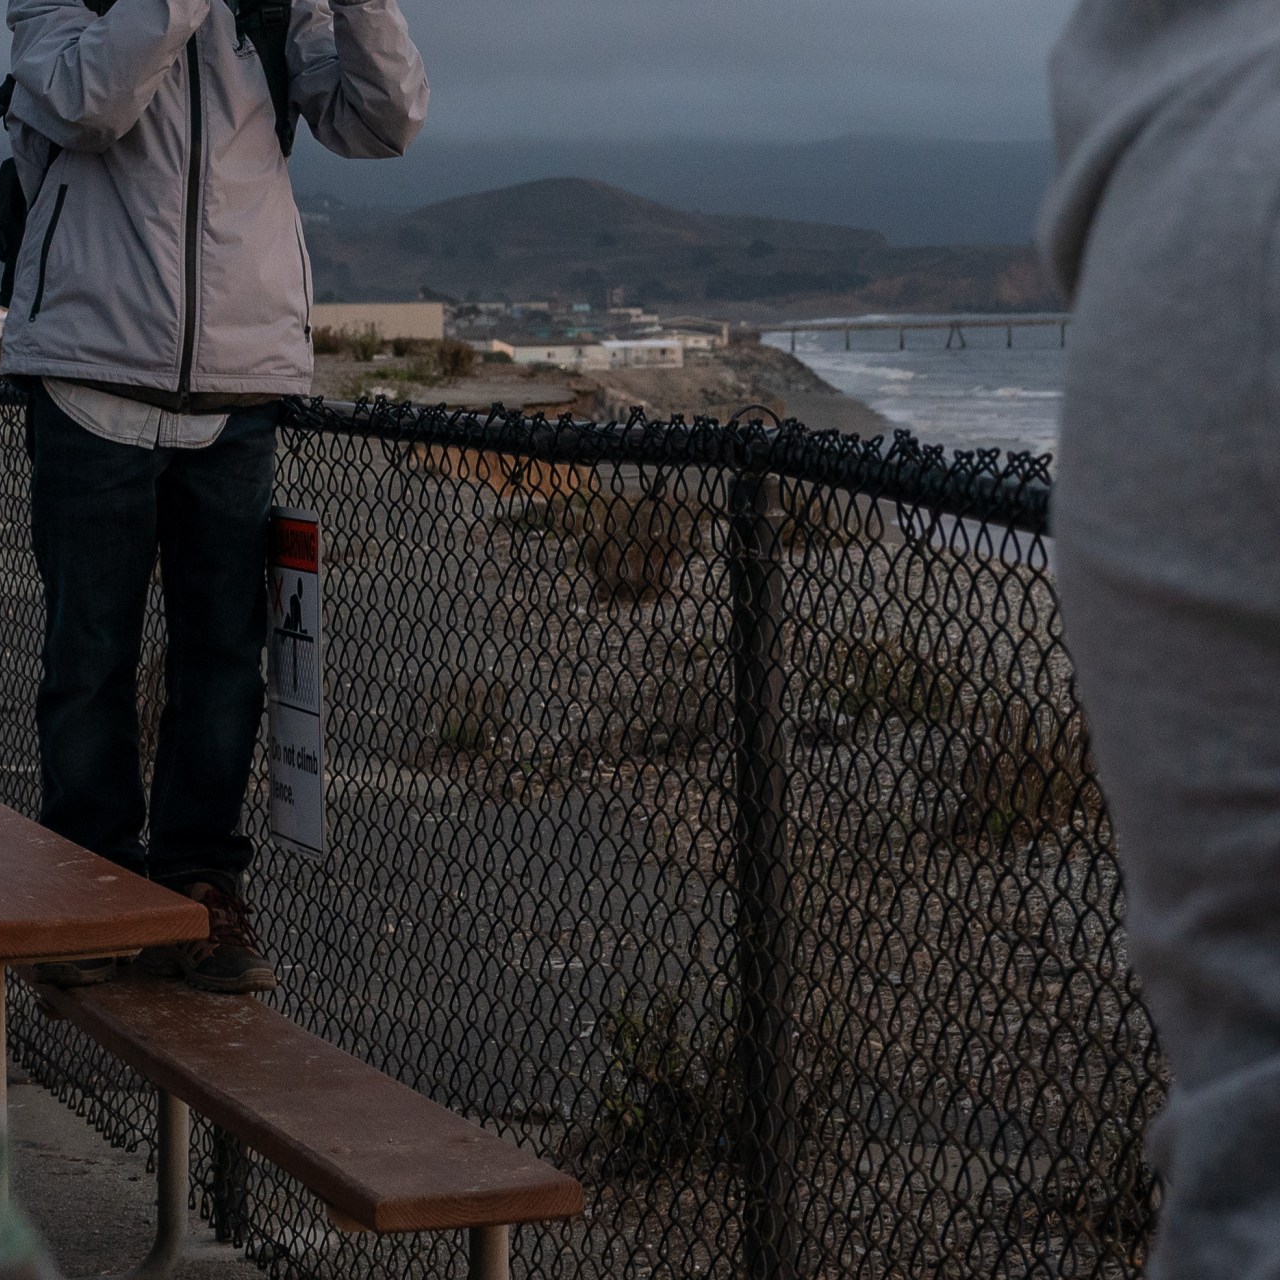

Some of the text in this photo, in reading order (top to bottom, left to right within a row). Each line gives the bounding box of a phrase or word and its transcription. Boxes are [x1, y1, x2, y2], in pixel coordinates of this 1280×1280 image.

[271, 736, 318, 775] Do not climb
